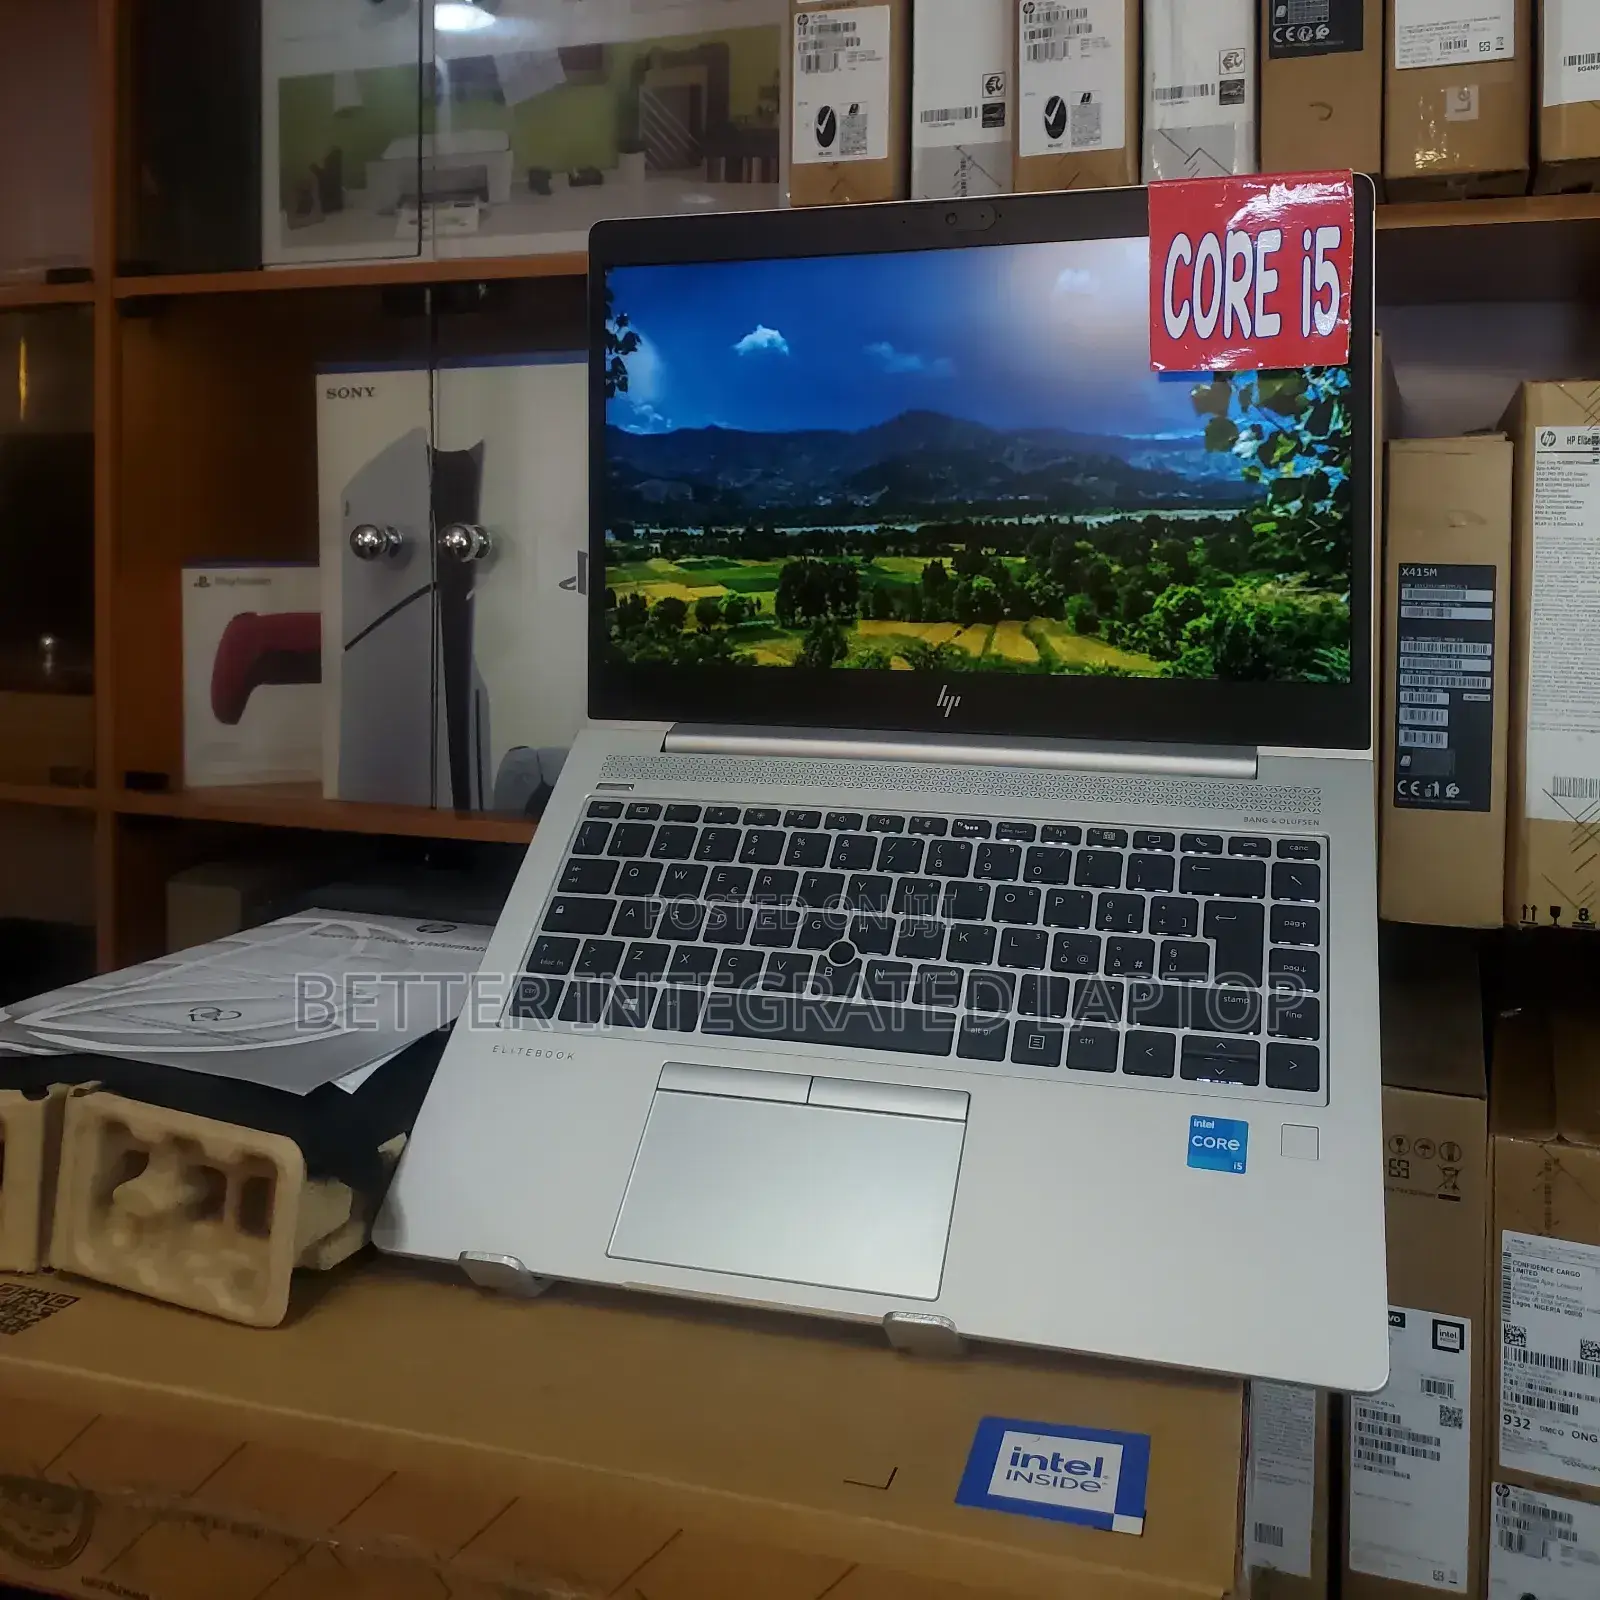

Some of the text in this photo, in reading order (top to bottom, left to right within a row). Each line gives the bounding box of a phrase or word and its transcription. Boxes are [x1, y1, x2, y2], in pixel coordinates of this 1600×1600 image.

[1163, 226, 1341, 340] CORE i5
[326, 387, 375, 399] SONY
[1566, 436, 1575, 445] HP
[1402, 567, 1437, 576] X415M
[1243, 816, 1268, 824] BANG
[1279, 818, 1320, 826] OLUFSEN
[629, 867, 640, 877] Q
[674, 870, 688, 880] W
[717, 873, 727, 882] E
[762, 876, 773, 886] R
[809, 878, 818, 888] T
[857, 882, 867, 891] Y
[905, 885, 915, 895] U
[1004, 893, 1016, 902] O
[1054, 897, 1064, 906] P
[625, 908, 635, 917] A
[671, 911, 679, 919] S
[716, 914, 726, 923] D
[763, 917, 772, 925] F
[811, 921, 822, 930] G
[859, 924, 869, 933] H
[908, 928, 916, 937] J
[958, 932, 969, 943] K
[1010, 937, 1018, 947] L
[1077, 954, 1088, 964] @
[1223, 995, 1250, 1005] stamp
[1286, 1011, 1302, 1019] fine
[1080, 1037, 1094, 1045] ctrl
[492, 1045, 575, 1060] ELITEBOOK
[1194, 1119, 1215, 1129] intel
[1234, 1162, 1243, 1170] i5
[1512, 1260, 1581, 1278] CONFIDENCE CARGO
[1512, 1267, 1538, 1277] LIMITED
[1512, 1299, 1531, 1308] Lagos
[1534, 1303, 1561, 1314] NIGERIA
[1439, 1329, 1457, 1339] intel
[1503, 1414, 1531, 1430] 932
[1571, 1430, 1598, 1443] ONG
[1010, 1446, 1104, 1478] intel
